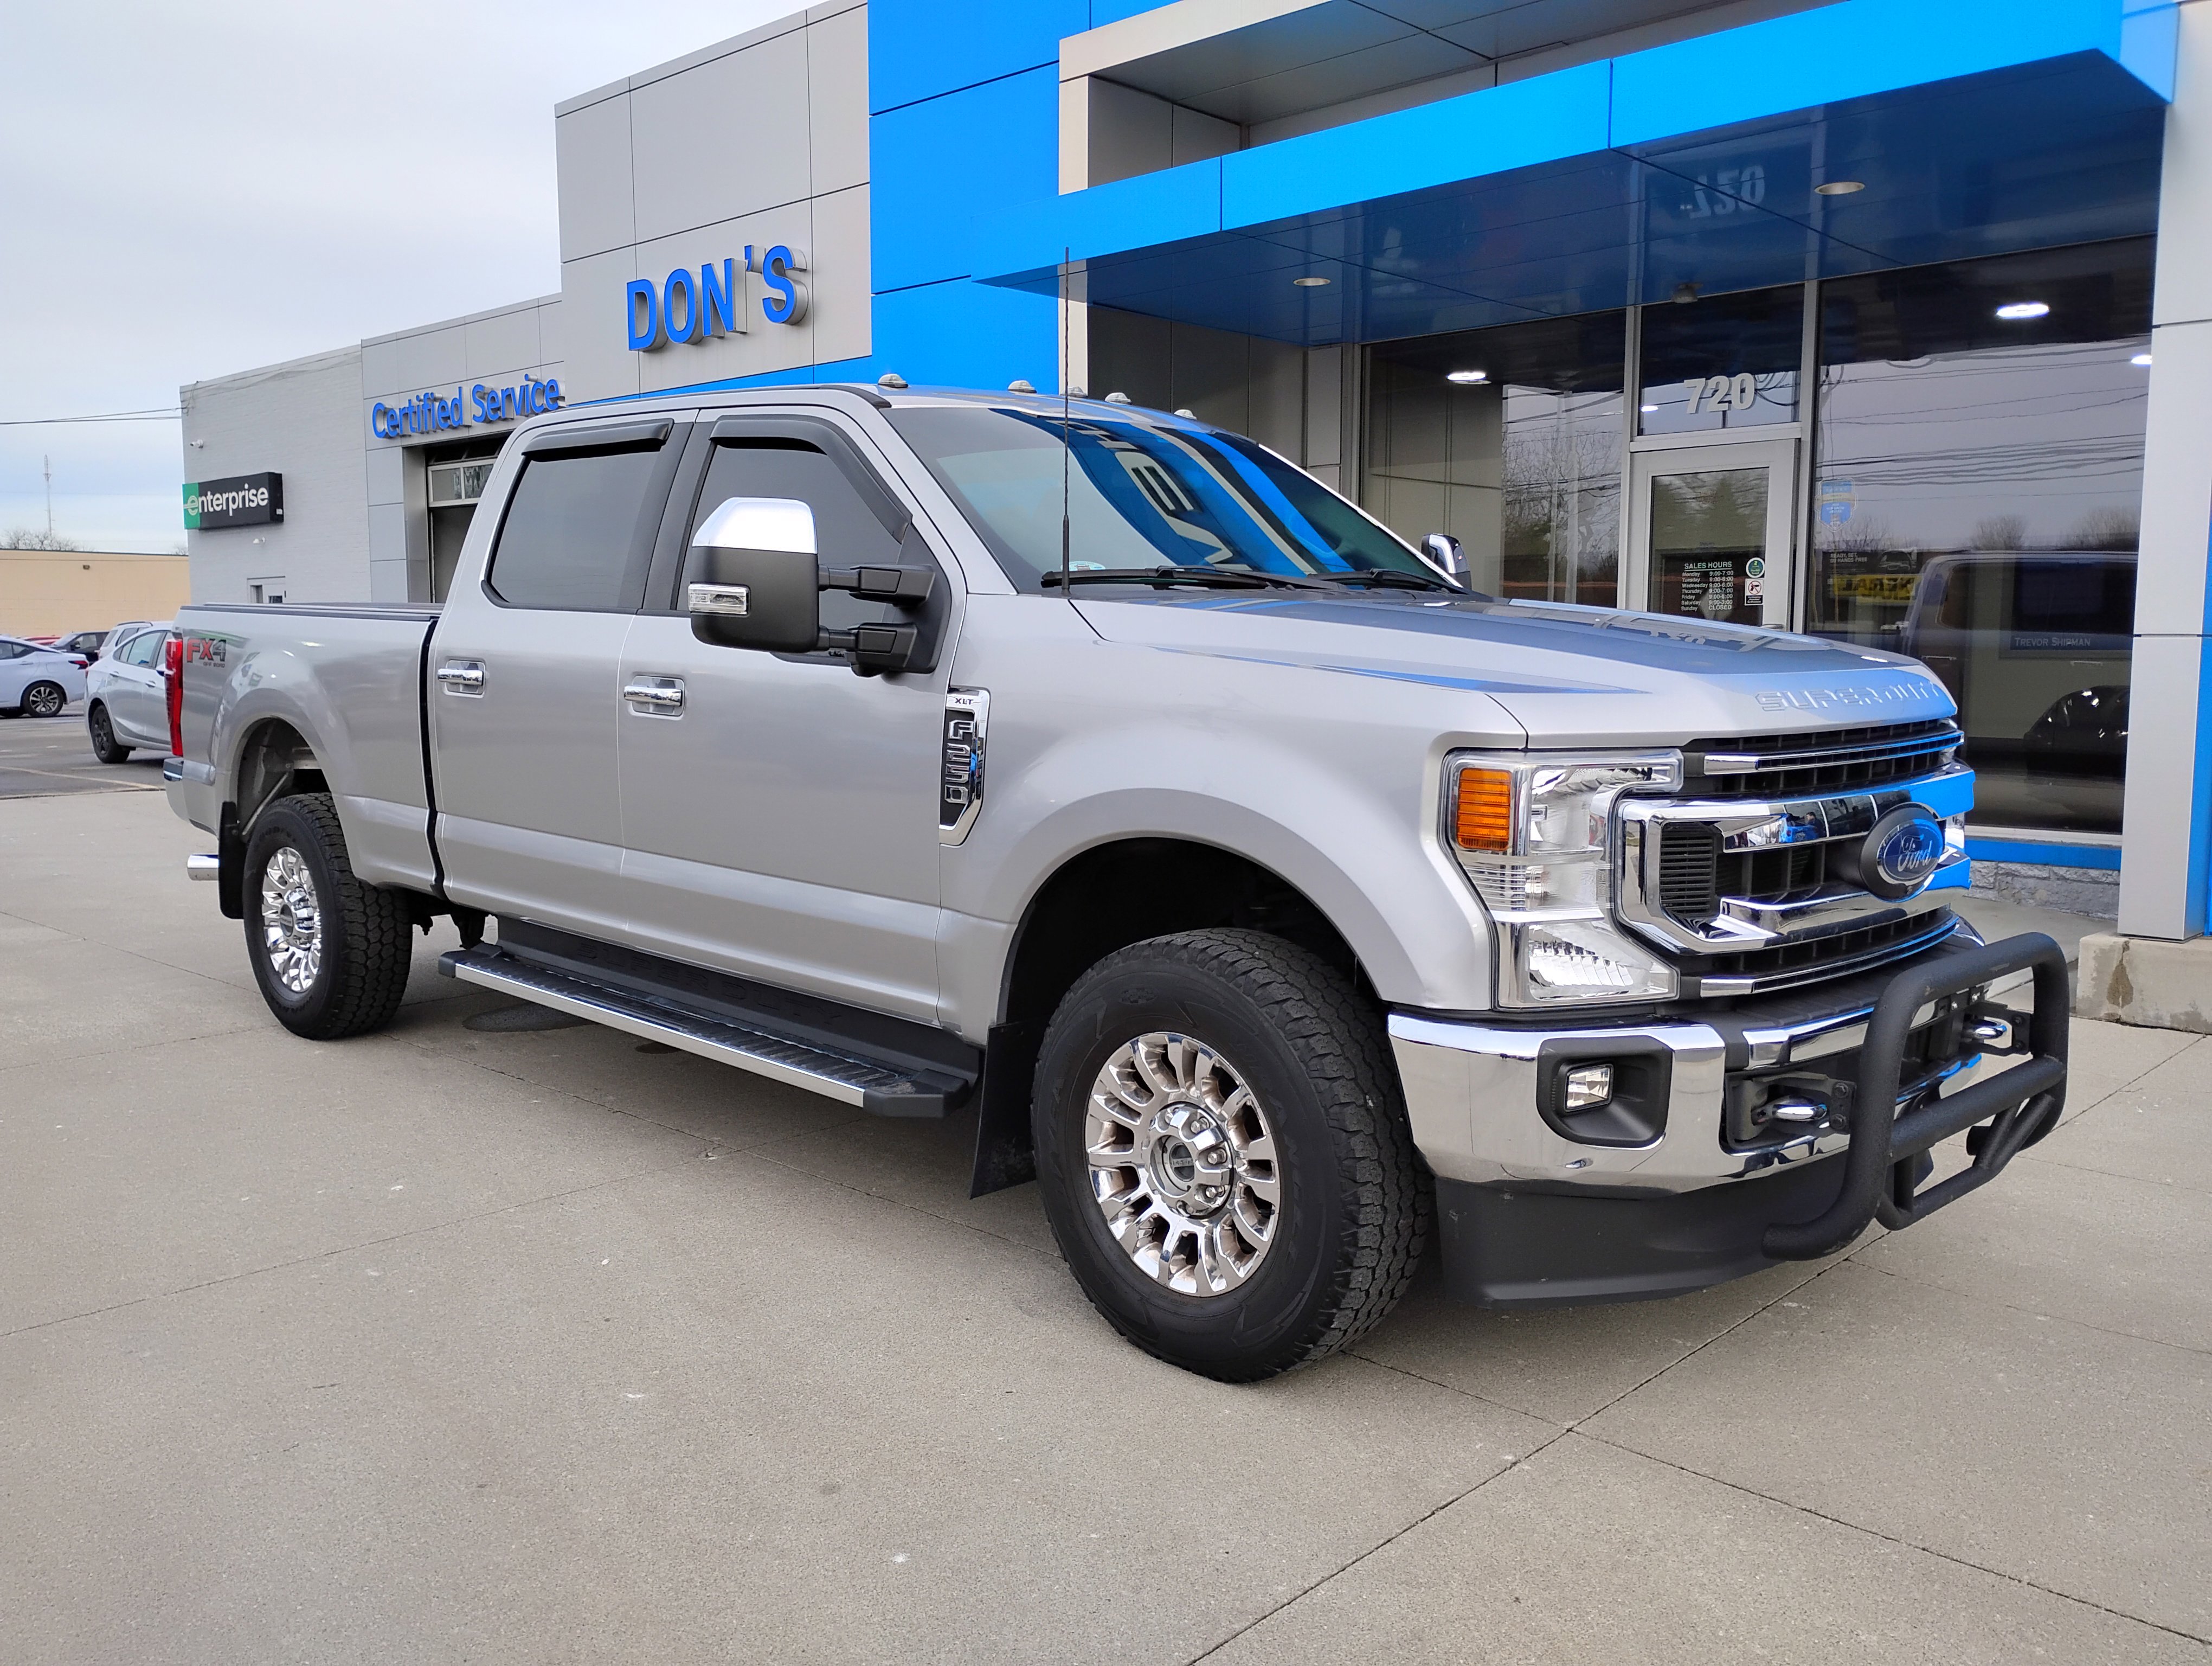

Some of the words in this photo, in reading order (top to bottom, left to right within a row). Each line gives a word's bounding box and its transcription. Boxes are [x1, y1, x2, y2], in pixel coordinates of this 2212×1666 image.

[627, 245, 805, 352] DON'S
[372, 386, 467, 438] Certified
[472, 374, 563, 423] Service
[1683, 373, 1756, 414] 720
[183, 483, 269, 517] enterprise
[187, 638, 227, 663] FX4
[2015, 637, 2048, 646] TREVOR
[954, 697, 974, 705] XLT
[1897, 834, 1932, 872] Ford
